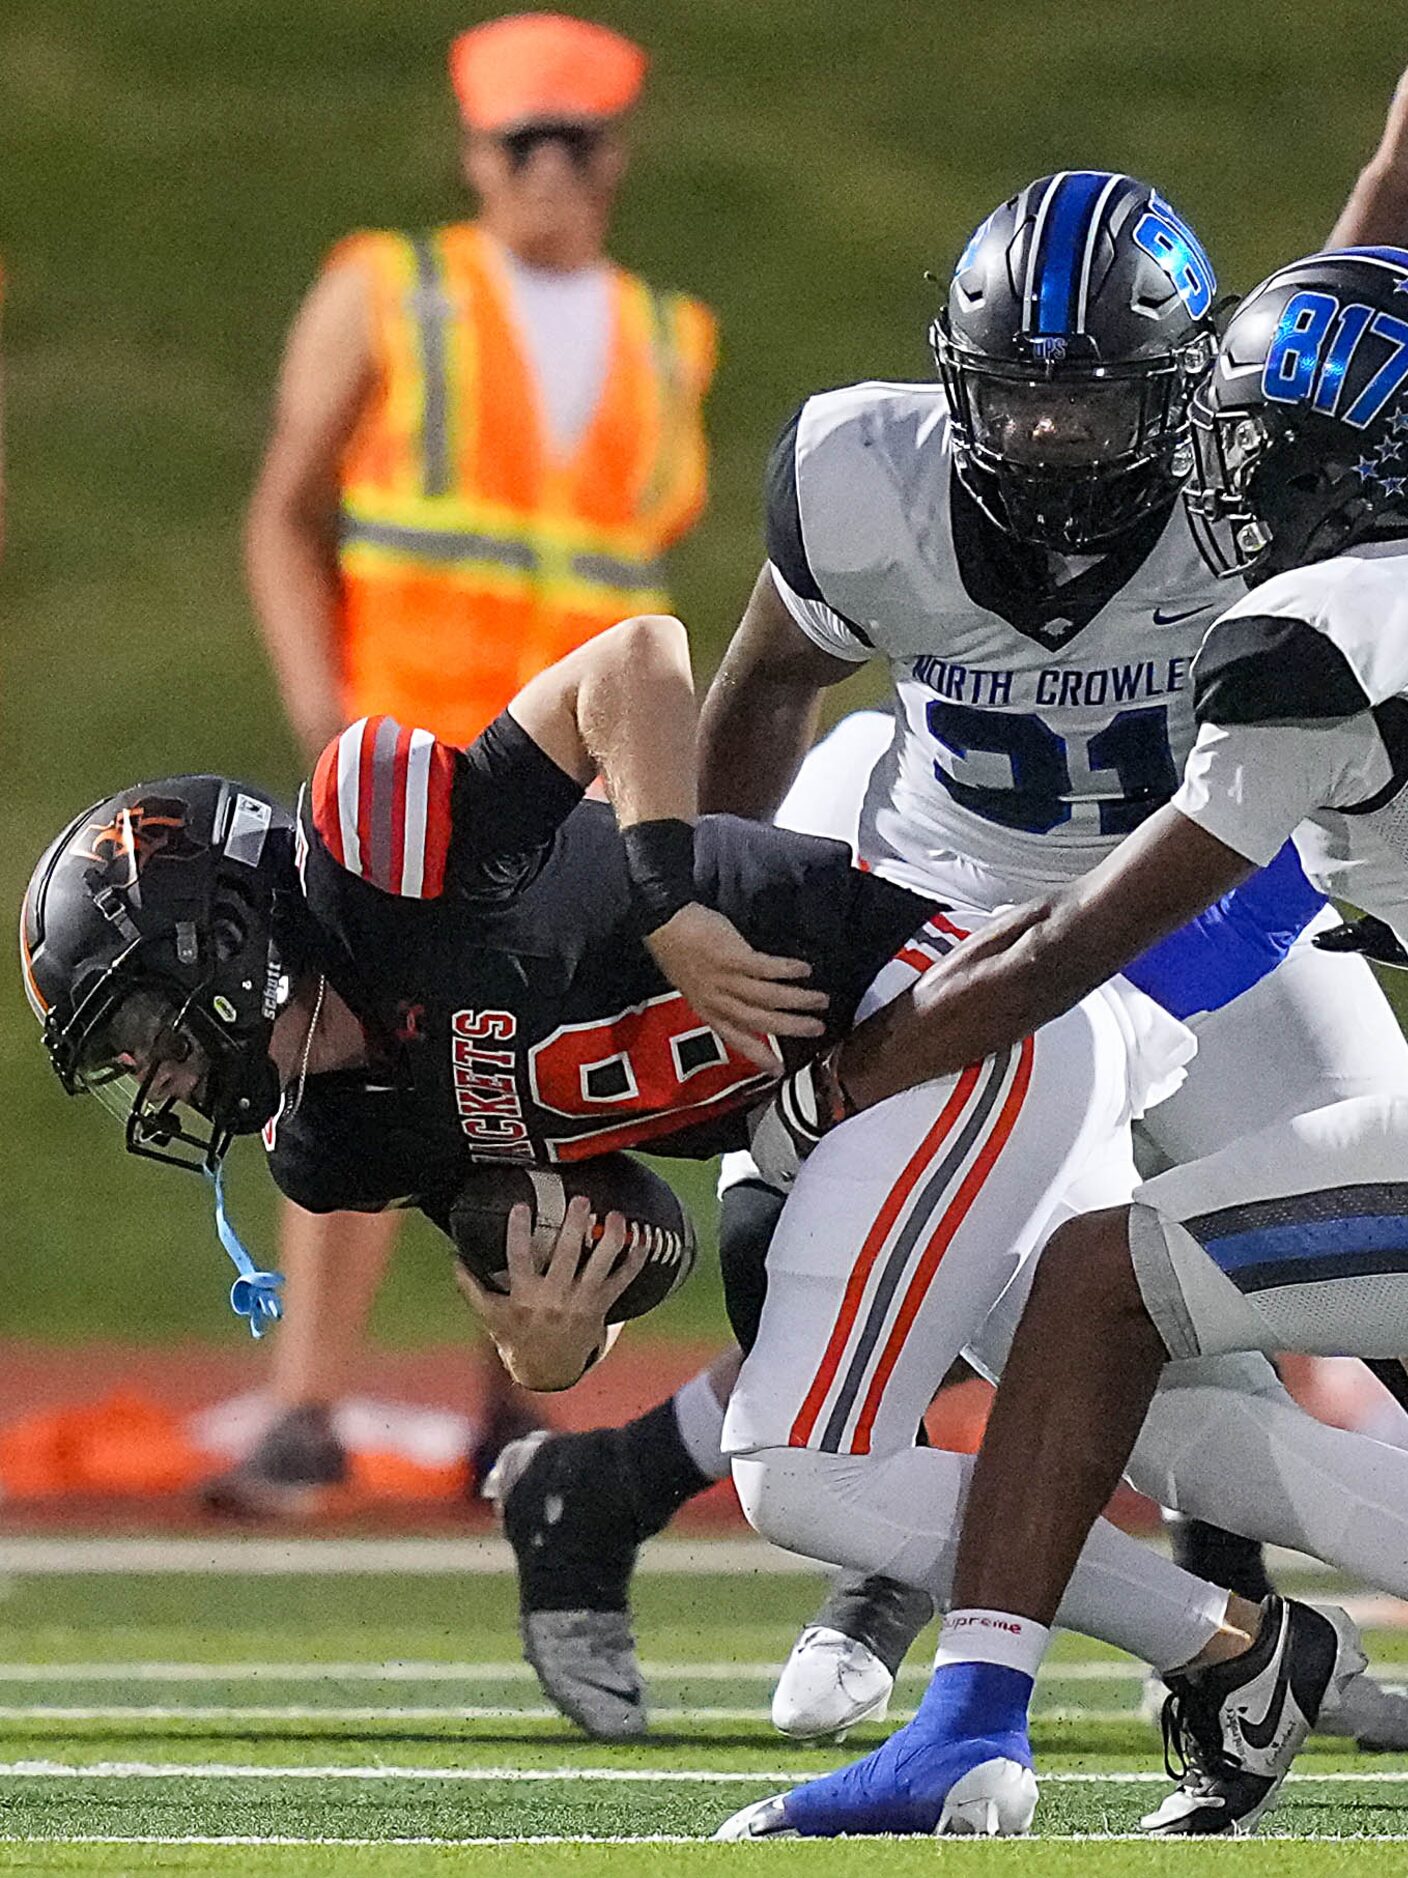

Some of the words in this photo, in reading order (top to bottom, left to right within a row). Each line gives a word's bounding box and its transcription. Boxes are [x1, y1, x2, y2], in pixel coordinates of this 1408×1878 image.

[912, 655, 1013, 704] NORTH
[1036, 656, 1192, 706] CROWLE
[451, 1009, 536, 1165] ACKETS
